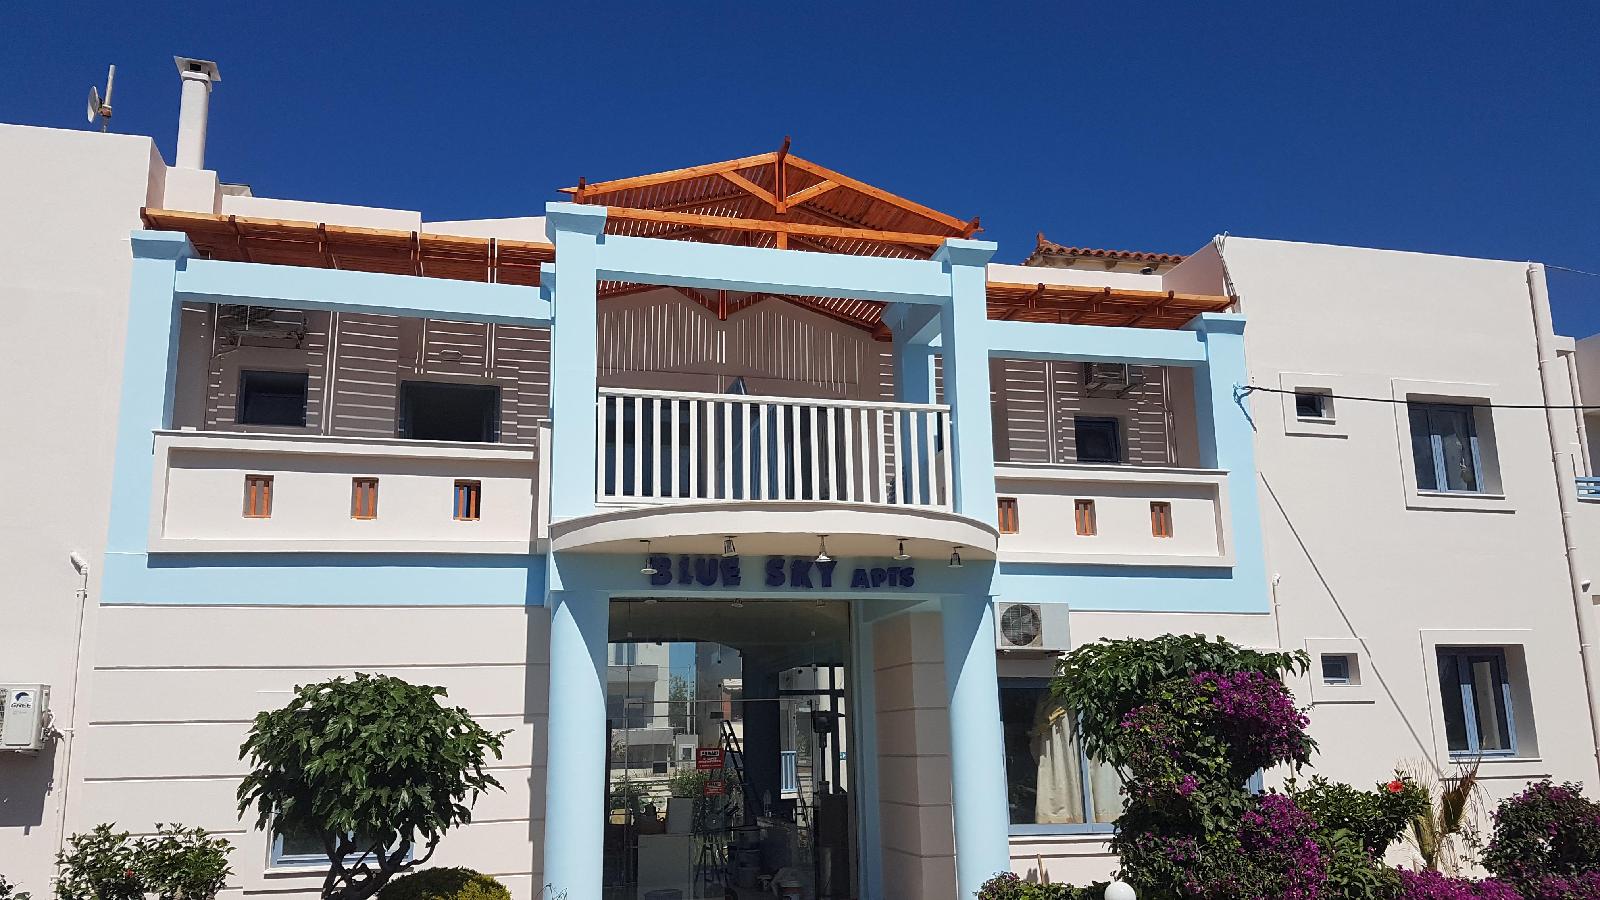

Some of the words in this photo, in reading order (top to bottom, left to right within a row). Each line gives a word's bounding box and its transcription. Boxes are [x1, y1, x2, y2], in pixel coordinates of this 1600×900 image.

[650, 557, 741, 587] BLUE
[766, 558, 837, 588] SKY
[851, 567, 915, 588] APTS
